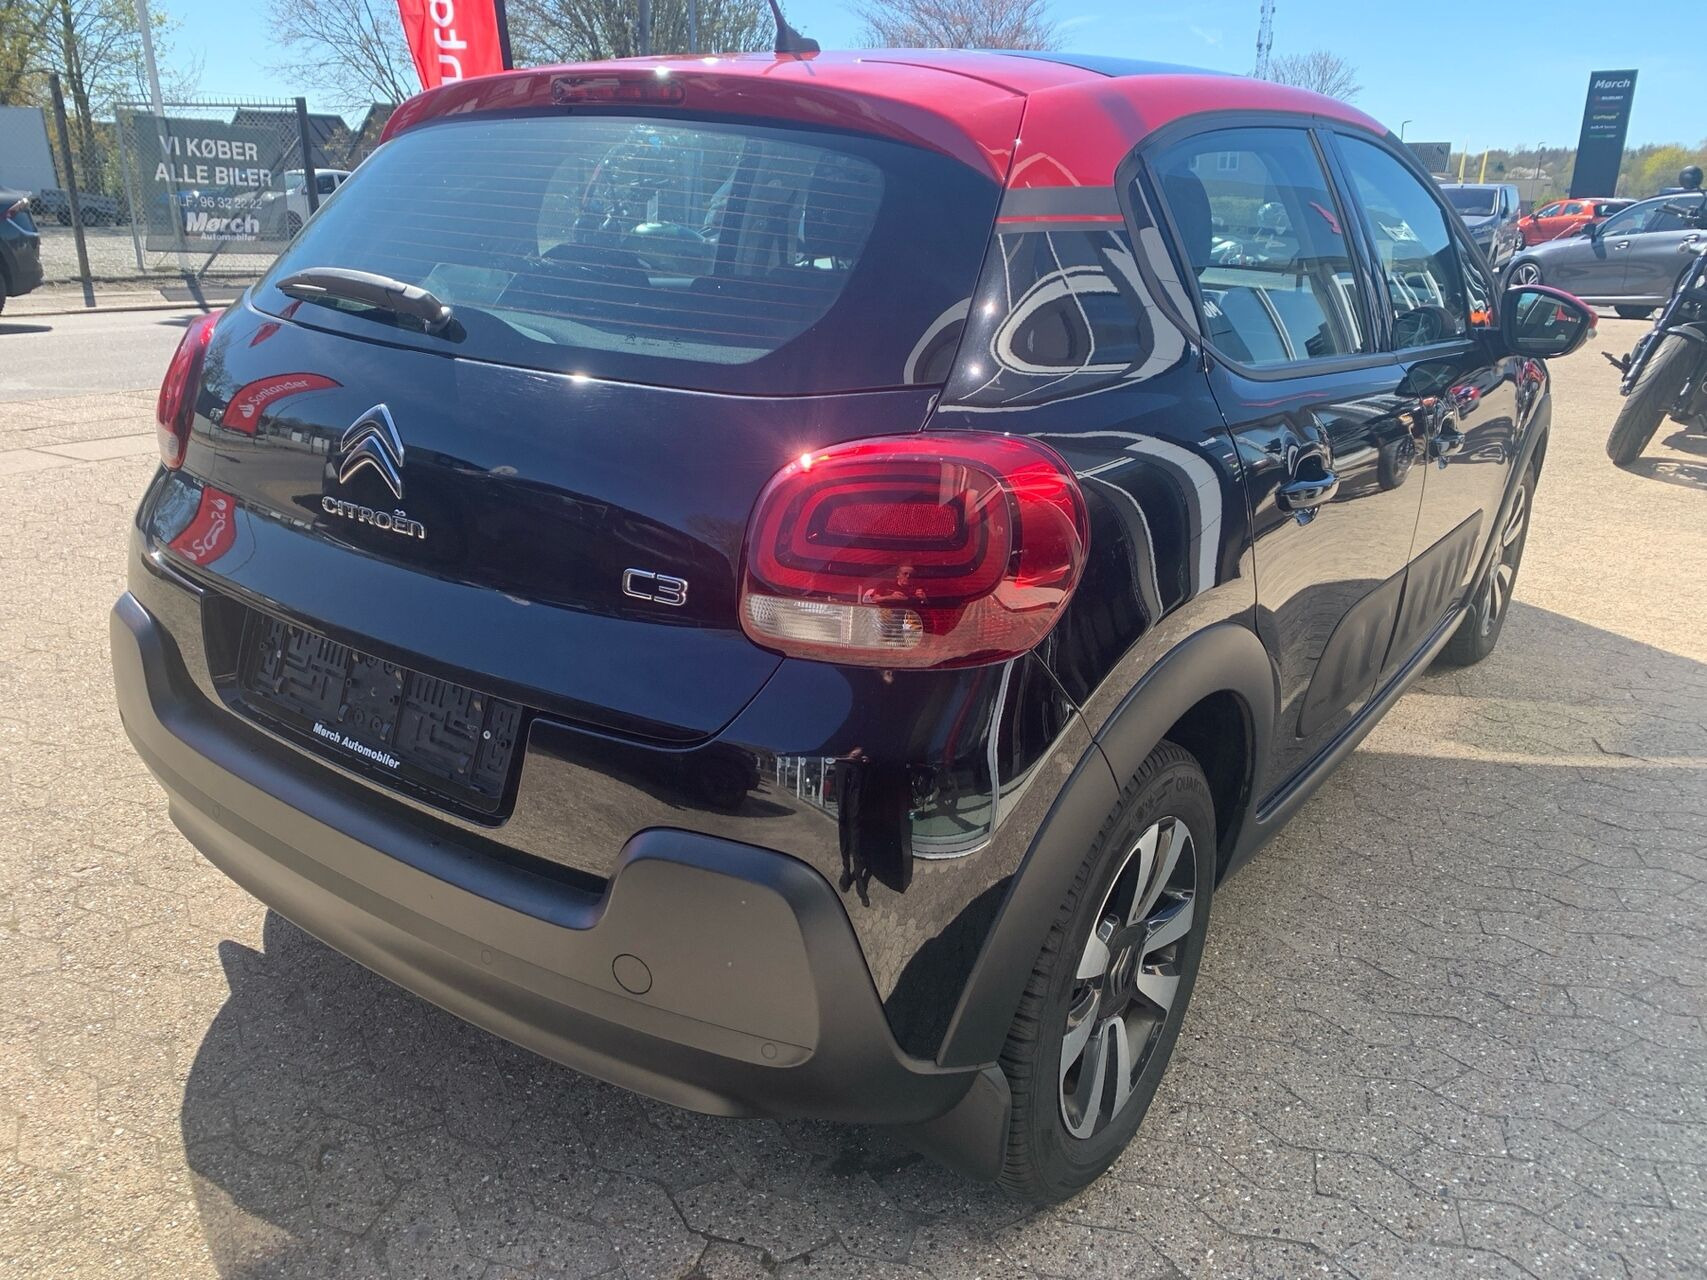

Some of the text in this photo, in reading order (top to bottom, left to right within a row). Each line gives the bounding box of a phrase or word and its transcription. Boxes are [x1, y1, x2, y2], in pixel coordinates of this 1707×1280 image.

[1594, 79, 1631, 89] Mørch
[159, 135, 258, 161] VI KØBER
[154, 163, 273, 188] ALLE BILER
[200, 196, 215, 209] 96
[217, 197, 232, 210] 32
[234, 198, 248, 209] 22
[250, 199, 263, 210] 22
[186, 211, 261, 233] Mørch
[200, 232, 257, 241] Automobiler
[247, 380, 308, 405] Santander
[321, 496, 427, 540] CITROËN
[622, 567, 689, 607] C3
[312, 722, 401, 769] Mørch Automobiler
